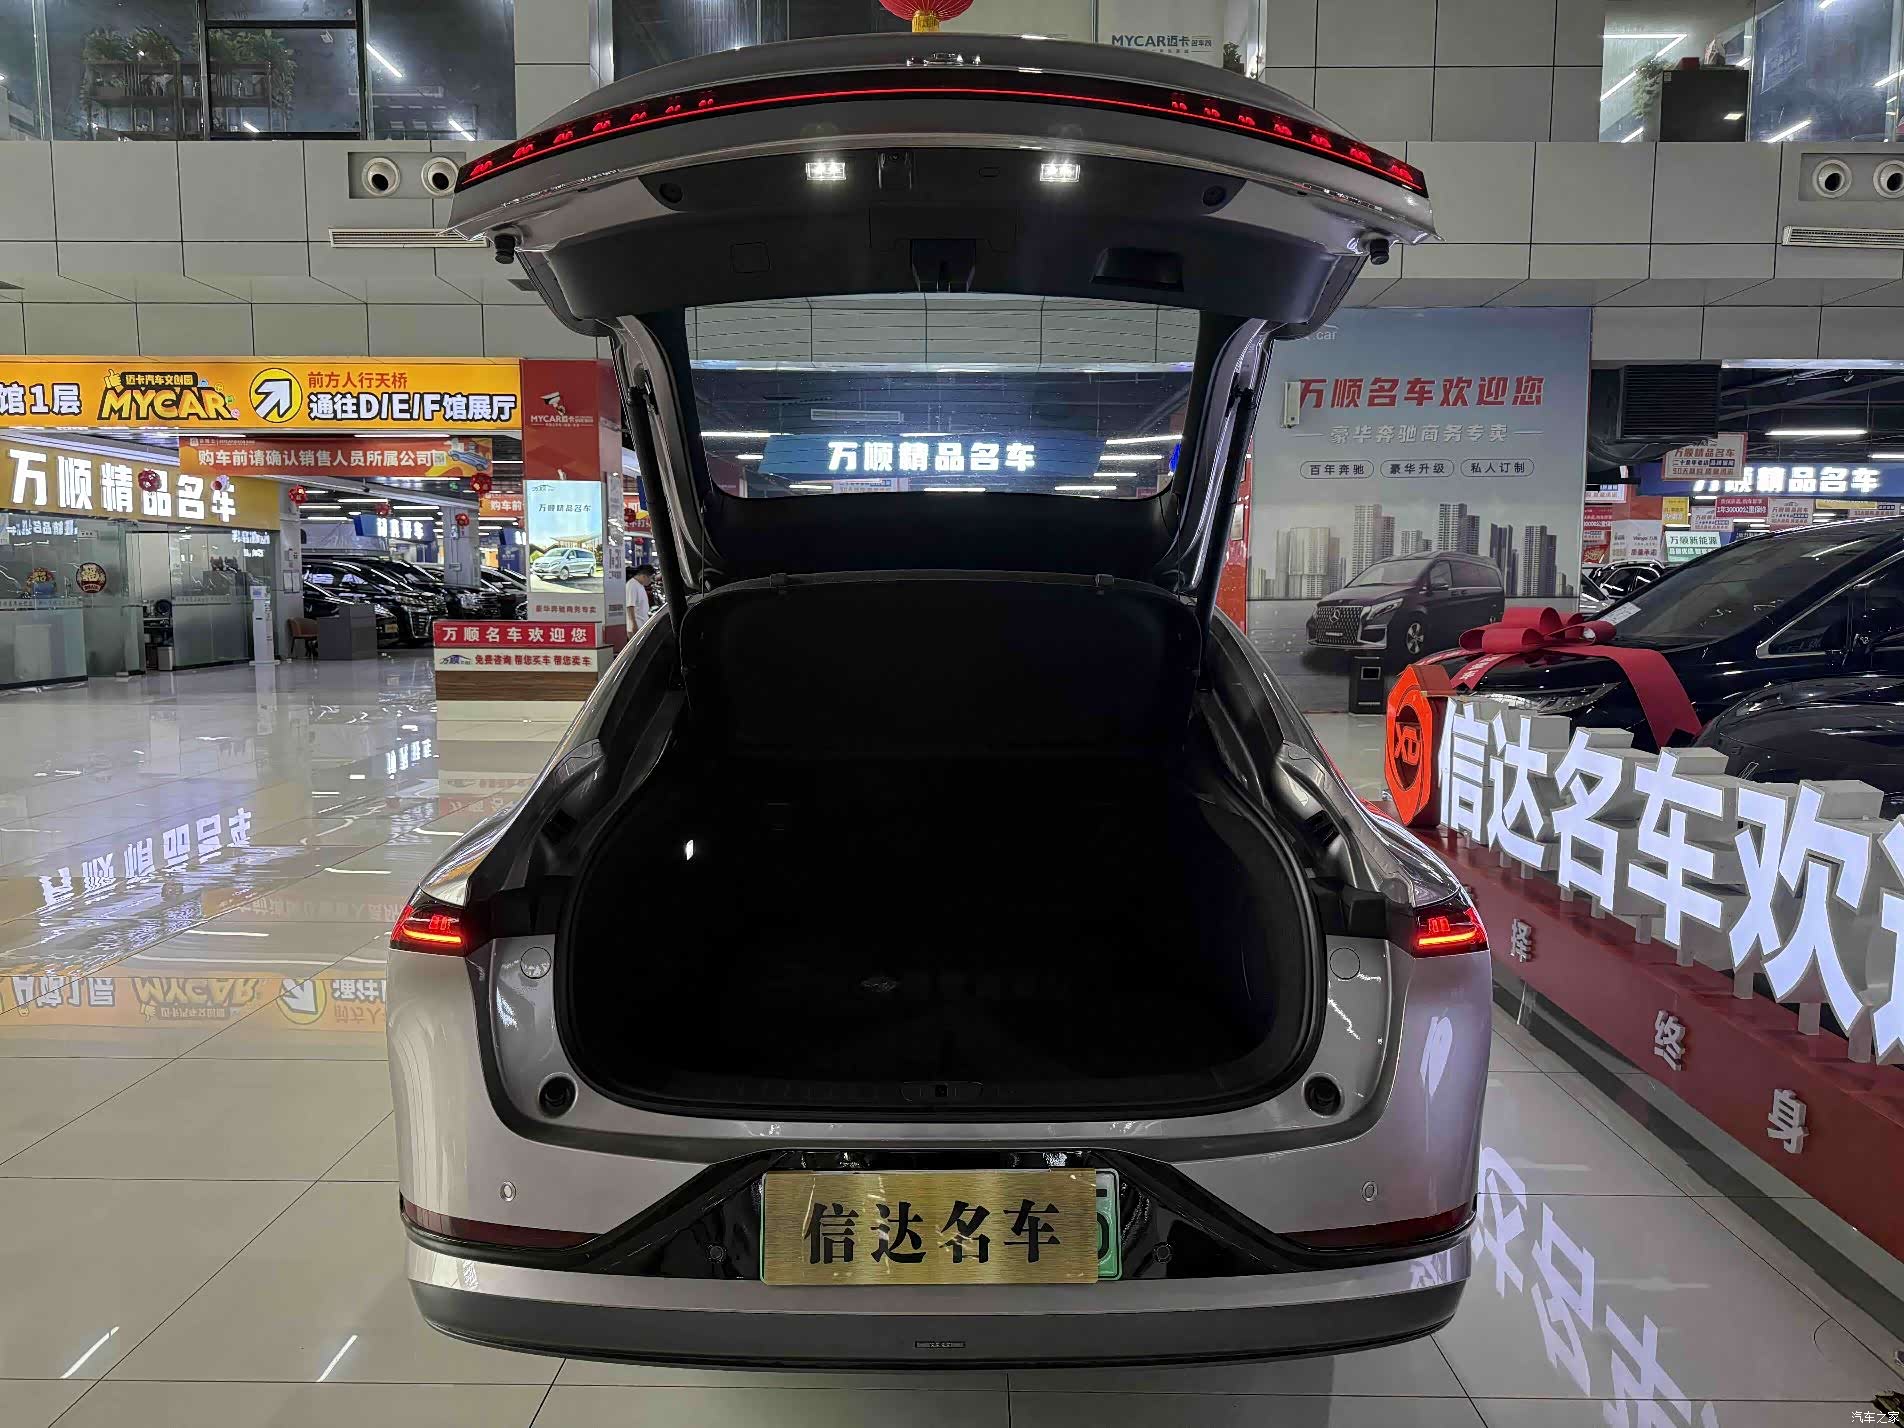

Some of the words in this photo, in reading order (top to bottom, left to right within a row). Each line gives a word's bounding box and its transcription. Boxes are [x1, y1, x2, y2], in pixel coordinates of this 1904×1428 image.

[307, 372, 408, 389] 前方人行天桥
[1299, 375, 1545, 409] 万顺名车欢迎您
[101, 388, 233, 419] MYCAR
[309, 393, 516, 420] 通往D/E/F馆展厅
[1330, 424, 1508, 444] 豪华奔驰商务专卖
[198, 449, 433, 467] 购车前请确认销售人员所属公司
[828, 440, 1036, 474] 万顺精品名车
[1309, 464, 1365, 476] 百年奔驰
[1390, 462, 1445, 475] 豪华升级
[1470, 461, 1526, 474] 私人订制
[9, 448, 237, 523] 万顺精品名车
[443, 627, 588, 643] 万顺名车欢迎您
[515, 655, 551, 666] 帮您买车
[1438, 698, 1904, 1065] 信达名车欢
[803, 1199, 1061, 1265] 信达名车
